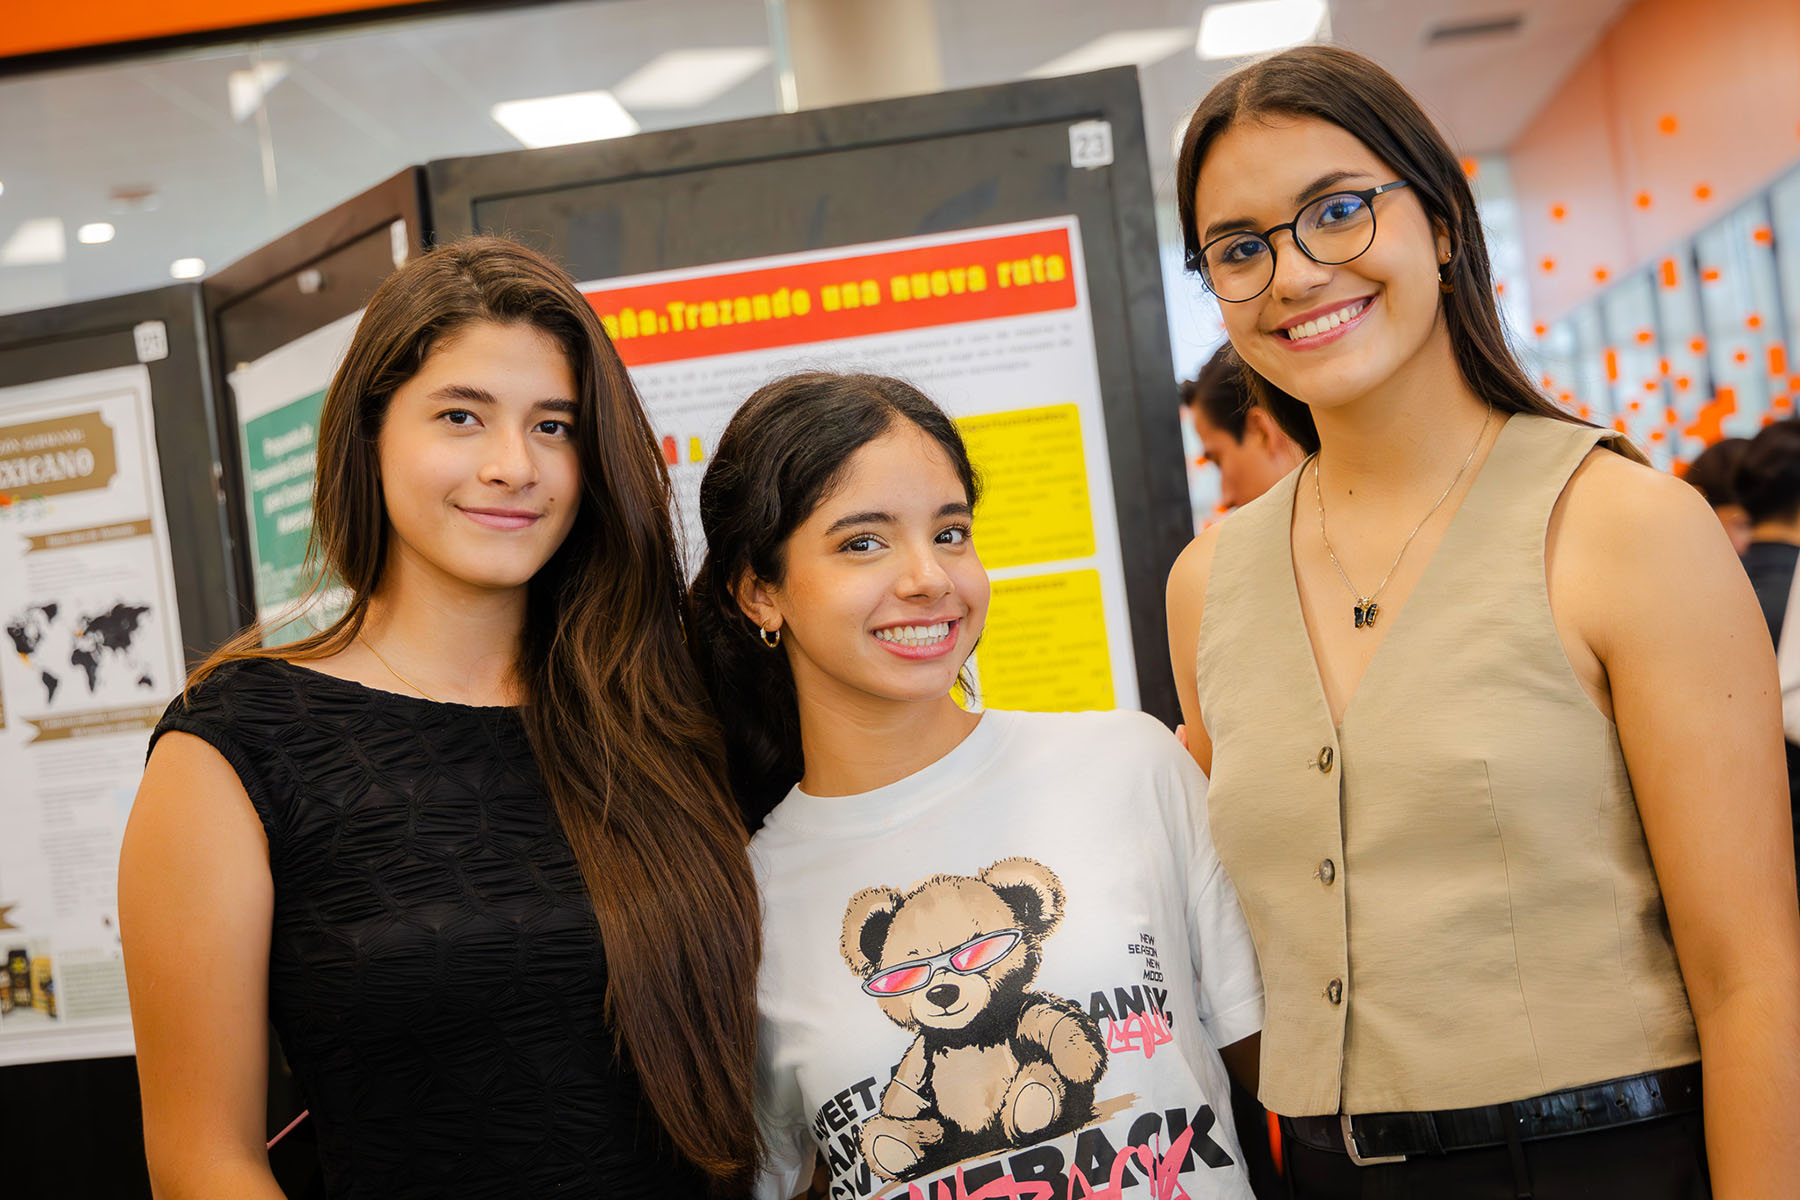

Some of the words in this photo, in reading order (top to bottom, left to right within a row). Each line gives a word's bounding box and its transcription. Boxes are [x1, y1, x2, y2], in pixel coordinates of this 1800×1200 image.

[821, 279, 881, 312] una
[890, 264, 987, 302] nueva
[996, 254, 1066, 288] ruta
[1139, 933, 1155, 945] NEW
[1128, 944, 1158, 958] SEASON
[1143, 969, 1164, 982] MOOD
[812, 1075, 877, 1141] WEET
